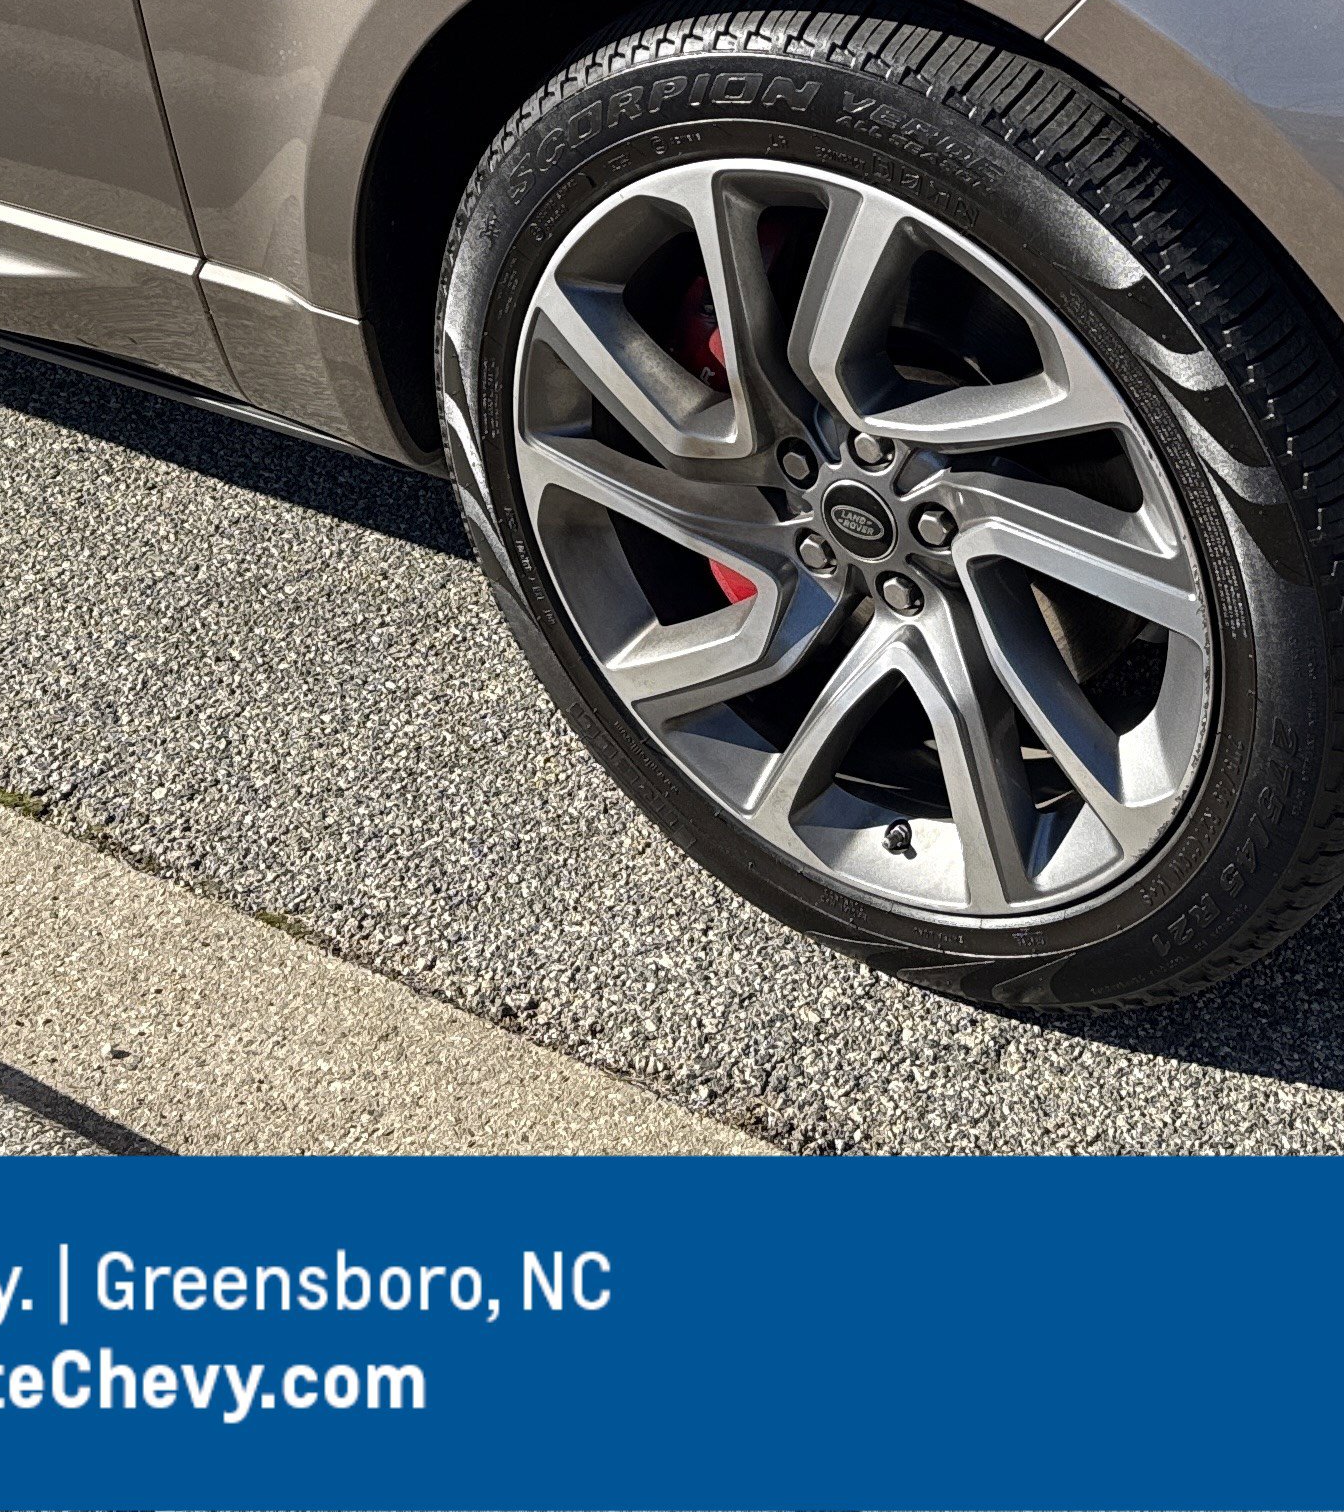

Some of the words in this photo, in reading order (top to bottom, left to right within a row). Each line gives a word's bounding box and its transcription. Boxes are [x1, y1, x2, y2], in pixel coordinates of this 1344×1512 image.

[508, 71, 823, 205] SCORPION
[841, 510, 866, 524] LAND
[844, 520, 874, 535] ROVER
